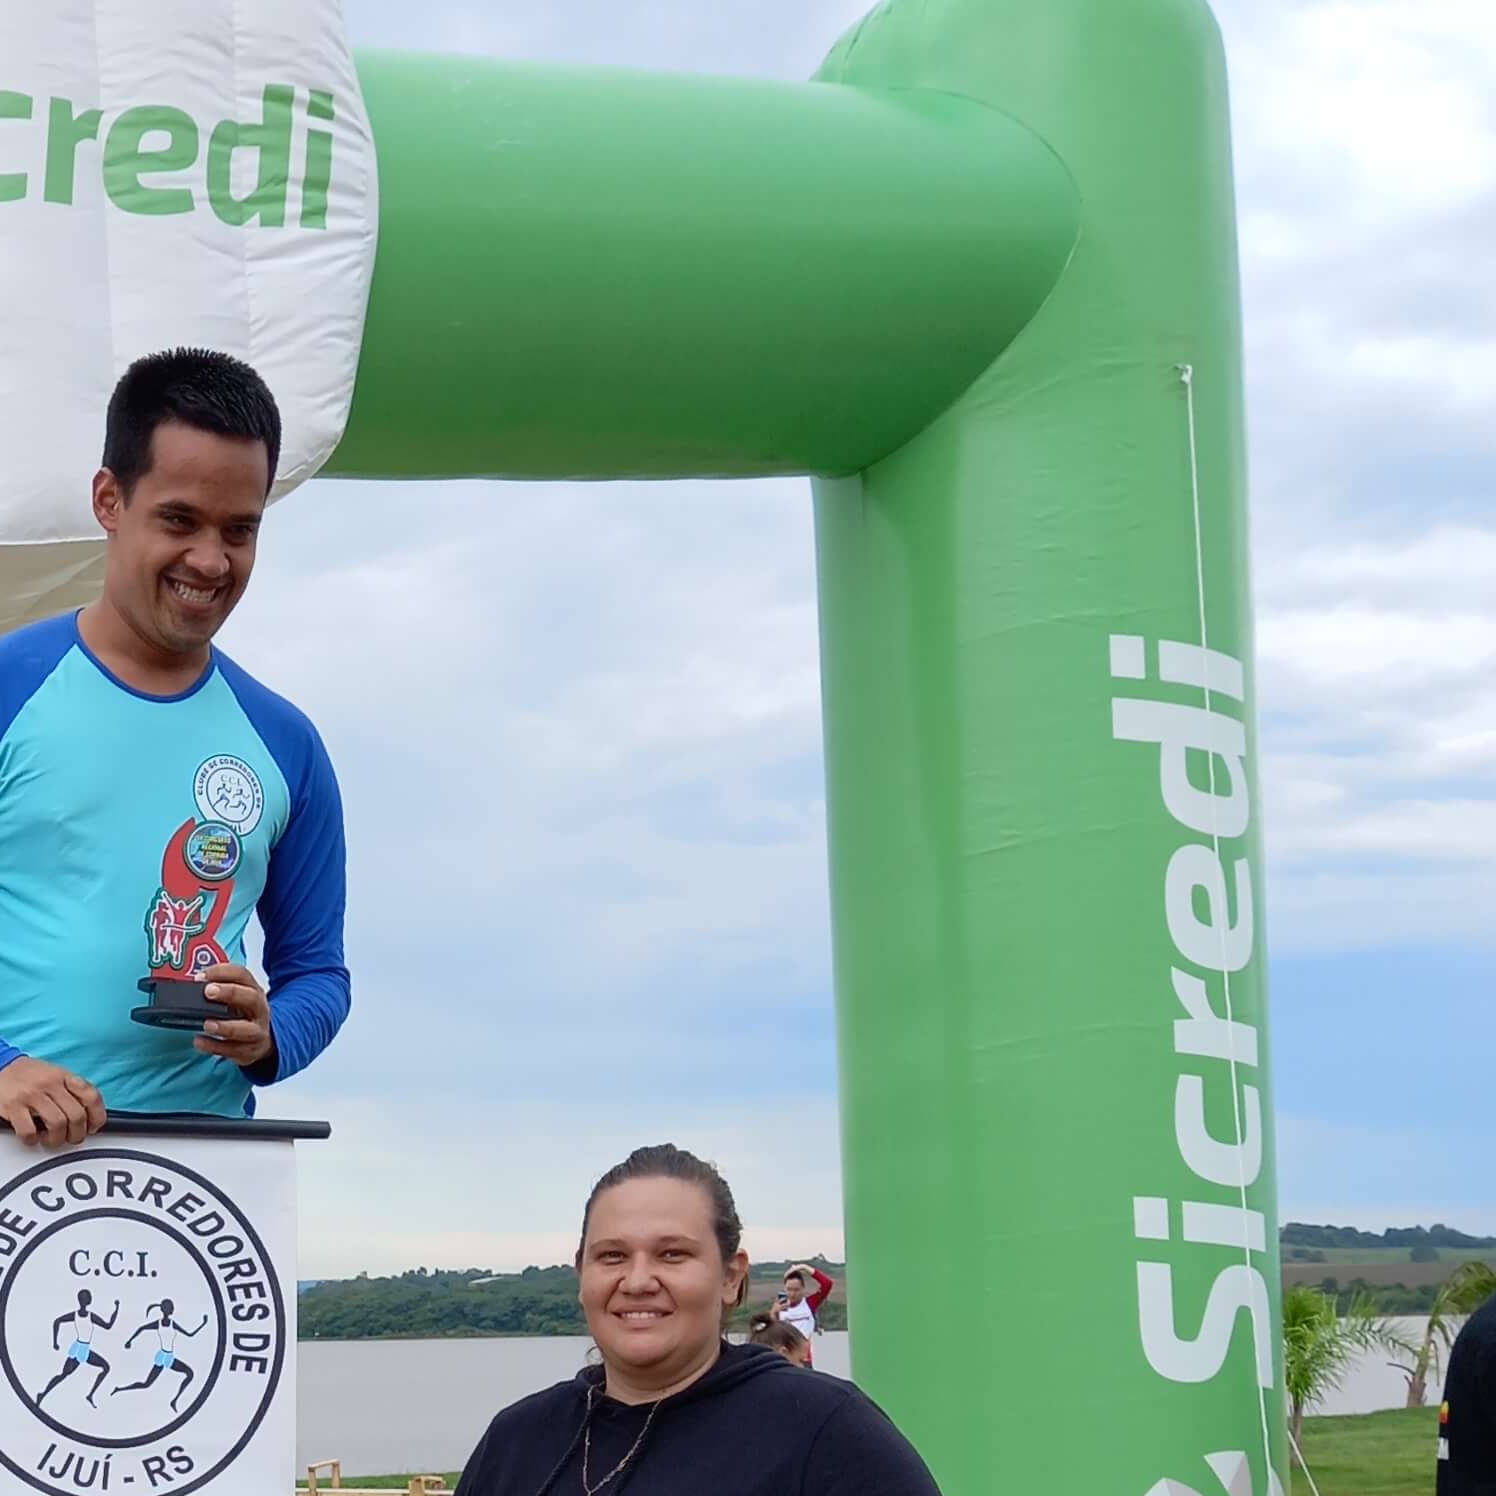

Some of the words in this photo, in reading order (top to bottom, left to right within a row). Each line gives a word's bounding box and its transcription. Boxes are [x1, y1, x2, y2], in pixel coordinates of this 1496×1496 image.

[1109, 633, 1275, 1390] Sicredi
[30, 1170, 270, 1321] CORREDORES
[229, 1332, 271, 1375] DE
[69, 1249, 158, 1278] C.C.I.
[37, 1443, 111, 1491] IJUÍ
[142, 1445, 196, 1487] RS
